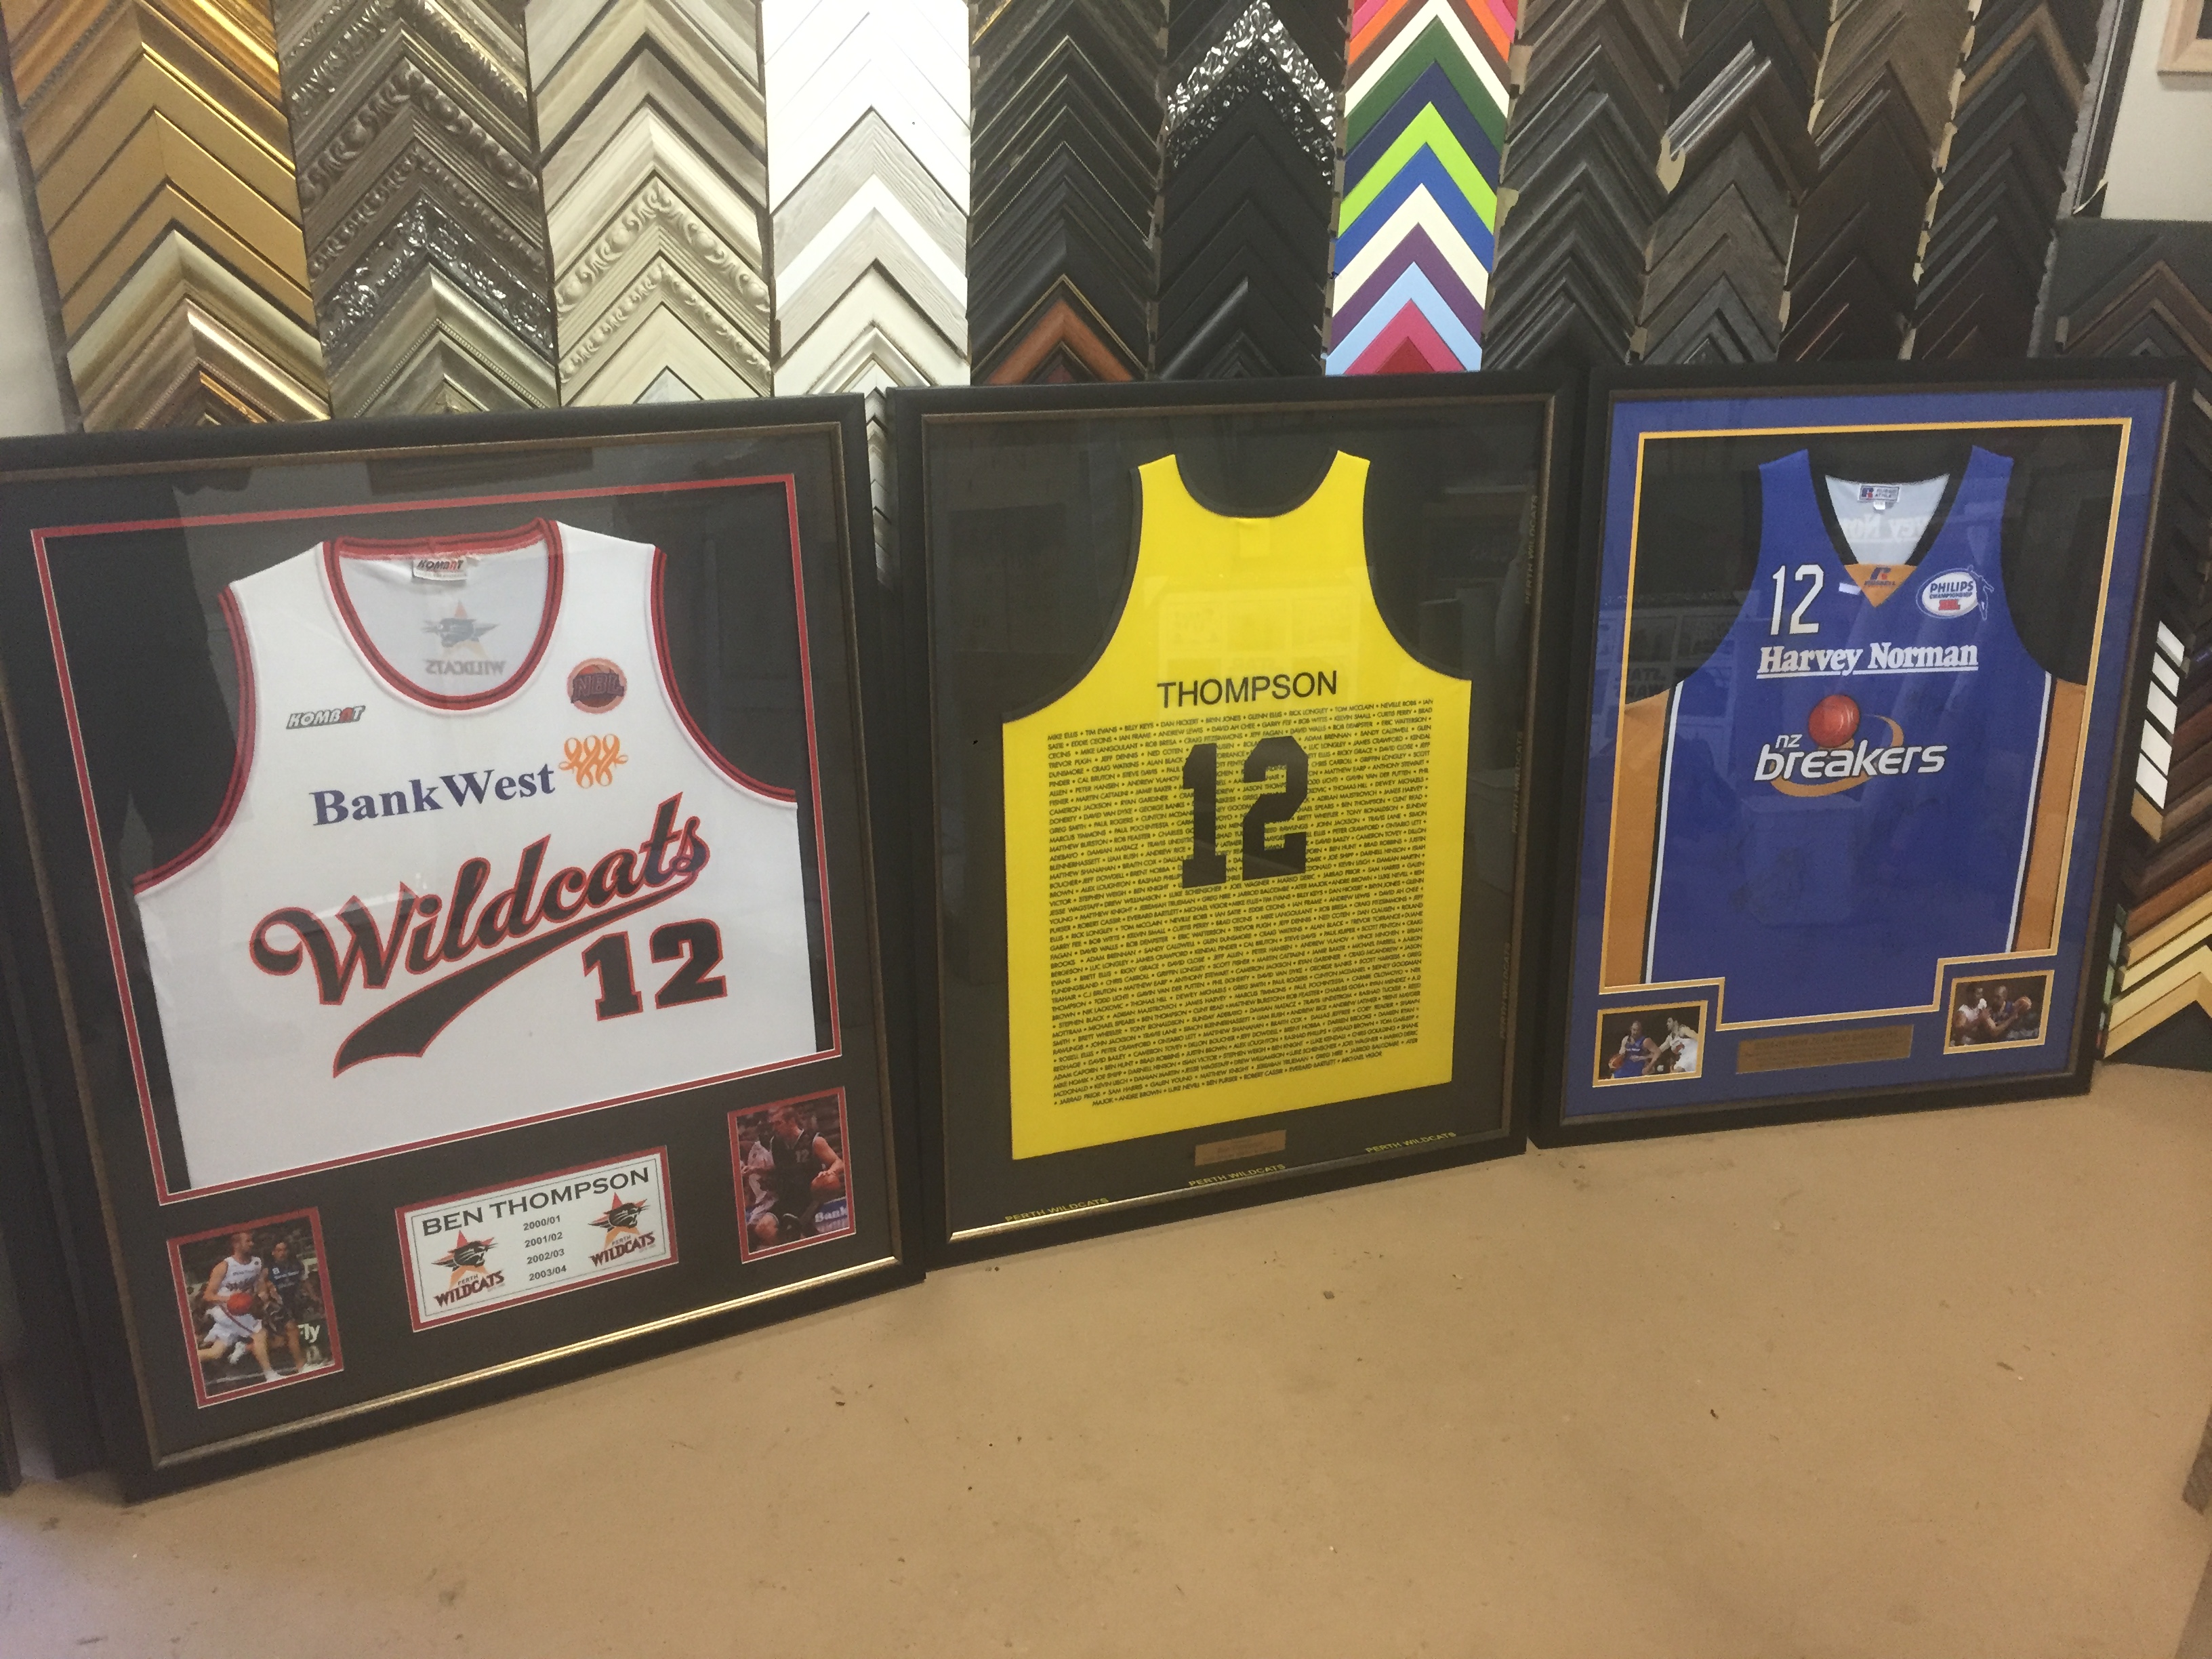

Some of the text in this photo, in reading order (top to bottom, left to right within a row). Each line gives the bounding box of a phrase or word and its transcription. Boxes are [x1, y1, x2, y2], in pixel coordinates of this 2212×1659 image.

[1770, 565, 1824, 636] 12
[1929, 581, 1974, 593] PHILIPS
[1757, 642, 1979, 676] Harvey Norman
[1156, 670, 1338, 709] THOMPSON
[1774, 733, 1803, 749] nz
[1754, 739, 1948, 781] breakers
[309, 763, 556, 826] BankWest
[1181, 735, 1309, 888] 12
[248, 791, 710, 1006] Wildcats
[582, 917, 728, 1021] 12
[1366, 1132, 1456, 1153] PERTH WILDCATS
[1188, 1164, 1286, 1186] PERTH WILDCATS
[422, 1167, 650, 1236] BEN THOMPSON
[1004, 1197, 1109, 1222] PERTH WILDCATS
[523, 1215, 561, 1231] 2000/01
[525, 1232, 563, 1248] 2001/02
[588, 1231, 655, 1267] WILDCATS
[611, 1235, 631, 1246] PERTH
[527, 1248, 565, 1265] 2002/03
[457, 1274, 478, 1286] PERTH
[529, 1265, 567, 1282] 2003/04
[433, 1269, 505, 1308] WILDCATS
